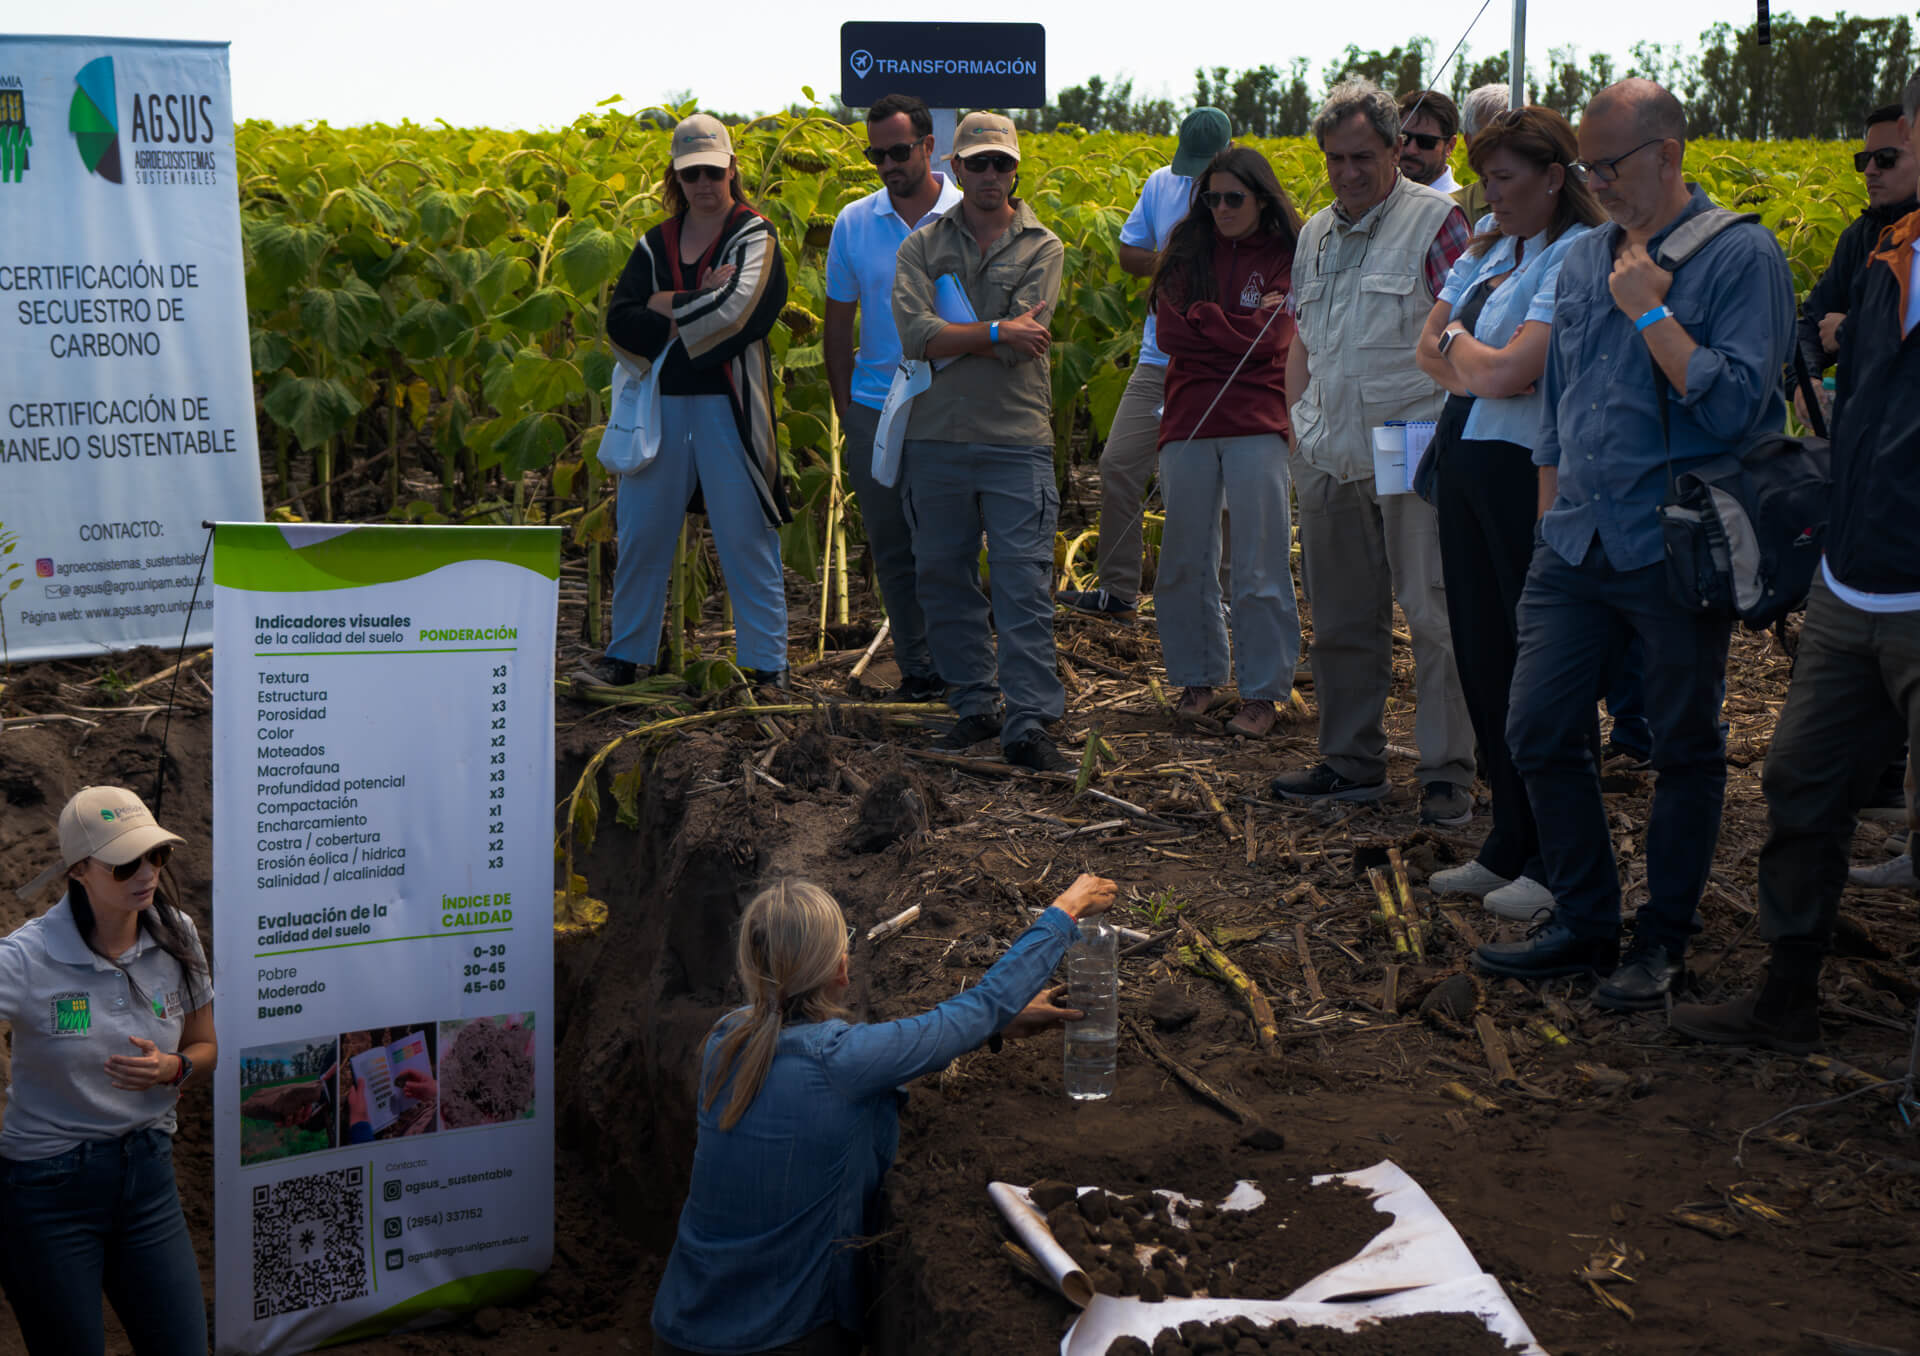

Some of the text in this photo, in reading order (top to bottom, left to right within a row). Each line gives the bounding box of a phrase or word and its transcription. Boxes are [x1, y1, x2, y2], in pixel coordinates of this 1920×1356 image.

[876, 57, 1037, 75] TRANSFORMACIÓN
[132, 93, 214, 144] AGSUS
[135, 150, 216, 170] AGROECOSISTEMAS
[136, 170, 217, 185] SUSTENTABLES
[0, 259, 199, 291] CERTIFICACIÓN DE
[18, 298, 185, 325] SECUESTRO DE
[50, 332, 160, 358] CARBONO
[9, 394, 210, 428] CERTIFICACIÓN DE
[0, 429, 237, 463] ANEJO SUSTENTABLE
[79, 520, 164, 542] CONTACTO:
[21, 610, 57, 627] Página
[255, 614, 411, 629] Indicadores visuales
[255, 631, 404, 645] de la calidad del suelo
[419, 625, 517, 642] PONDERACIÓN
[258, 672, 309, 684] Textura
[493, 665, 507, 678] x3
[258, 689, 328, 703] Estructura
[492, 682, 507, 695] x3
[257, 707, 327, 721] Porosidad
[492, 700, 506, 712] x3
[491, 717, 506, 730] x2
[257, 727, 294, 740] Color
[491, 735, 506, 747] x2
[257, 744, 325, 759] Moteados
[490, 752, 505, 765] x3
[257, 762, 340, 777] Macrofauna
[490, 769, 505, 782] x3
[257, 775, 406, 796] Profundidad potencial
[489, 786, 505, 799] x3
[257, 796, 358, 816] Compactación
[489, 804, 502, 817] x1
[257, 814, 367, 833] Encharcamiento
[489, 821, 504, 834] x2
[257, 832, 381, 851] Costra / cobertura
[488, 839, 504, 851] x2
[257, 854, 305, 870] Erosión
[308, 852, 348, 866] éolica
[352, 847, 359, 864] /
[488, 856, 504, 869] x3
[257, 863, 406, 889] Salinidad / alcalinidad
[442, 893, 511, 910] ÍNDICE DE
[258, 904, 387, 930] Evaluación de la
[442, 909, 512, 927] CALIDAD
[258, 922, 371, 946] calidad del suelo
[258, 967, 297, 982] Pobre
[258, 980, 326, 1000] Moderado
[258, 1003, 303, 1019] Bueno
[405, 1168, 513, 1194] agsus_sustentable
[406, 1207, 483, 1231] (2954) 337152
